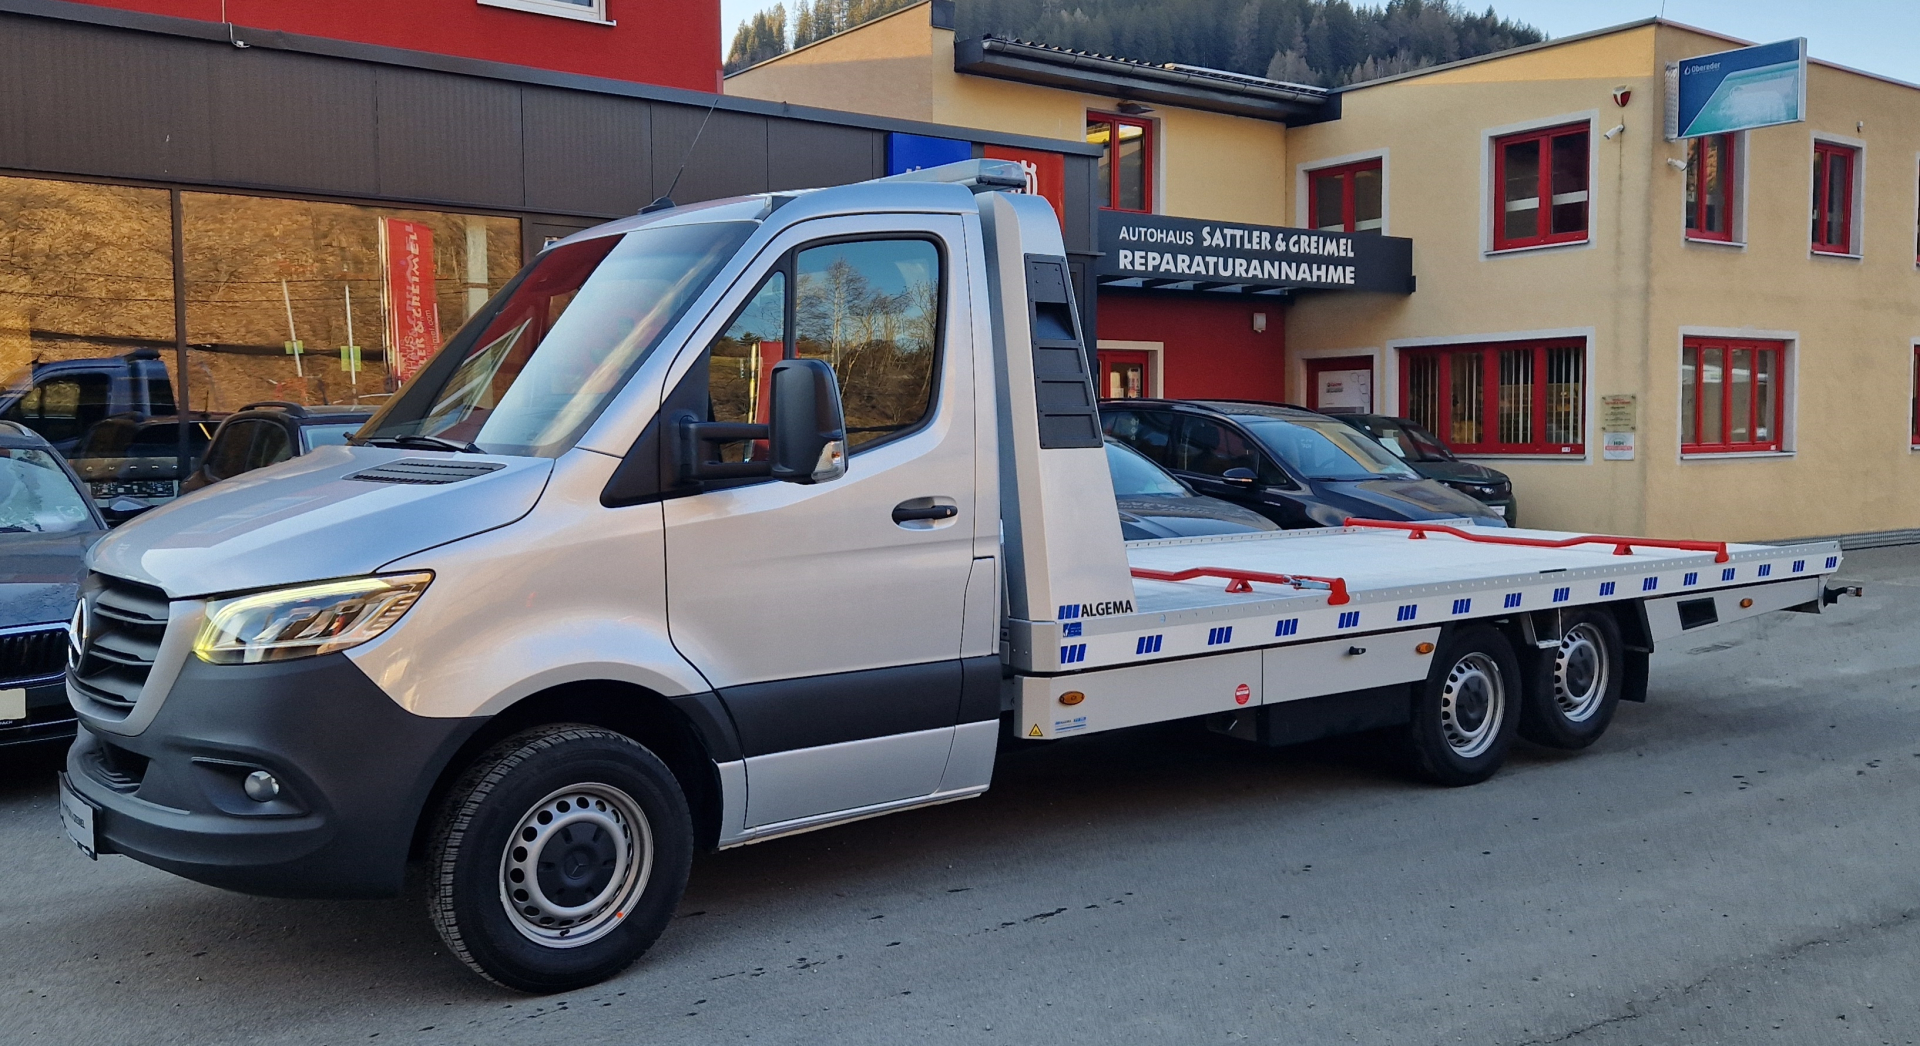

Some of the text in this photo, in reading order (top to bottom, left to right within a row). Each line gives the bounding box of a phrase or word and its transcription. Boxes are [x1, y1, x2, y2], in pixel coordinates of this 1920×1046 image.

[1119, 225, 1355, 257] AUTOHAUS SATTLER & GREIMEL
[1119, 249, 1355, 285] REPARATURANNAHME
[1081, 600, 1133, 618] ALGEMA
